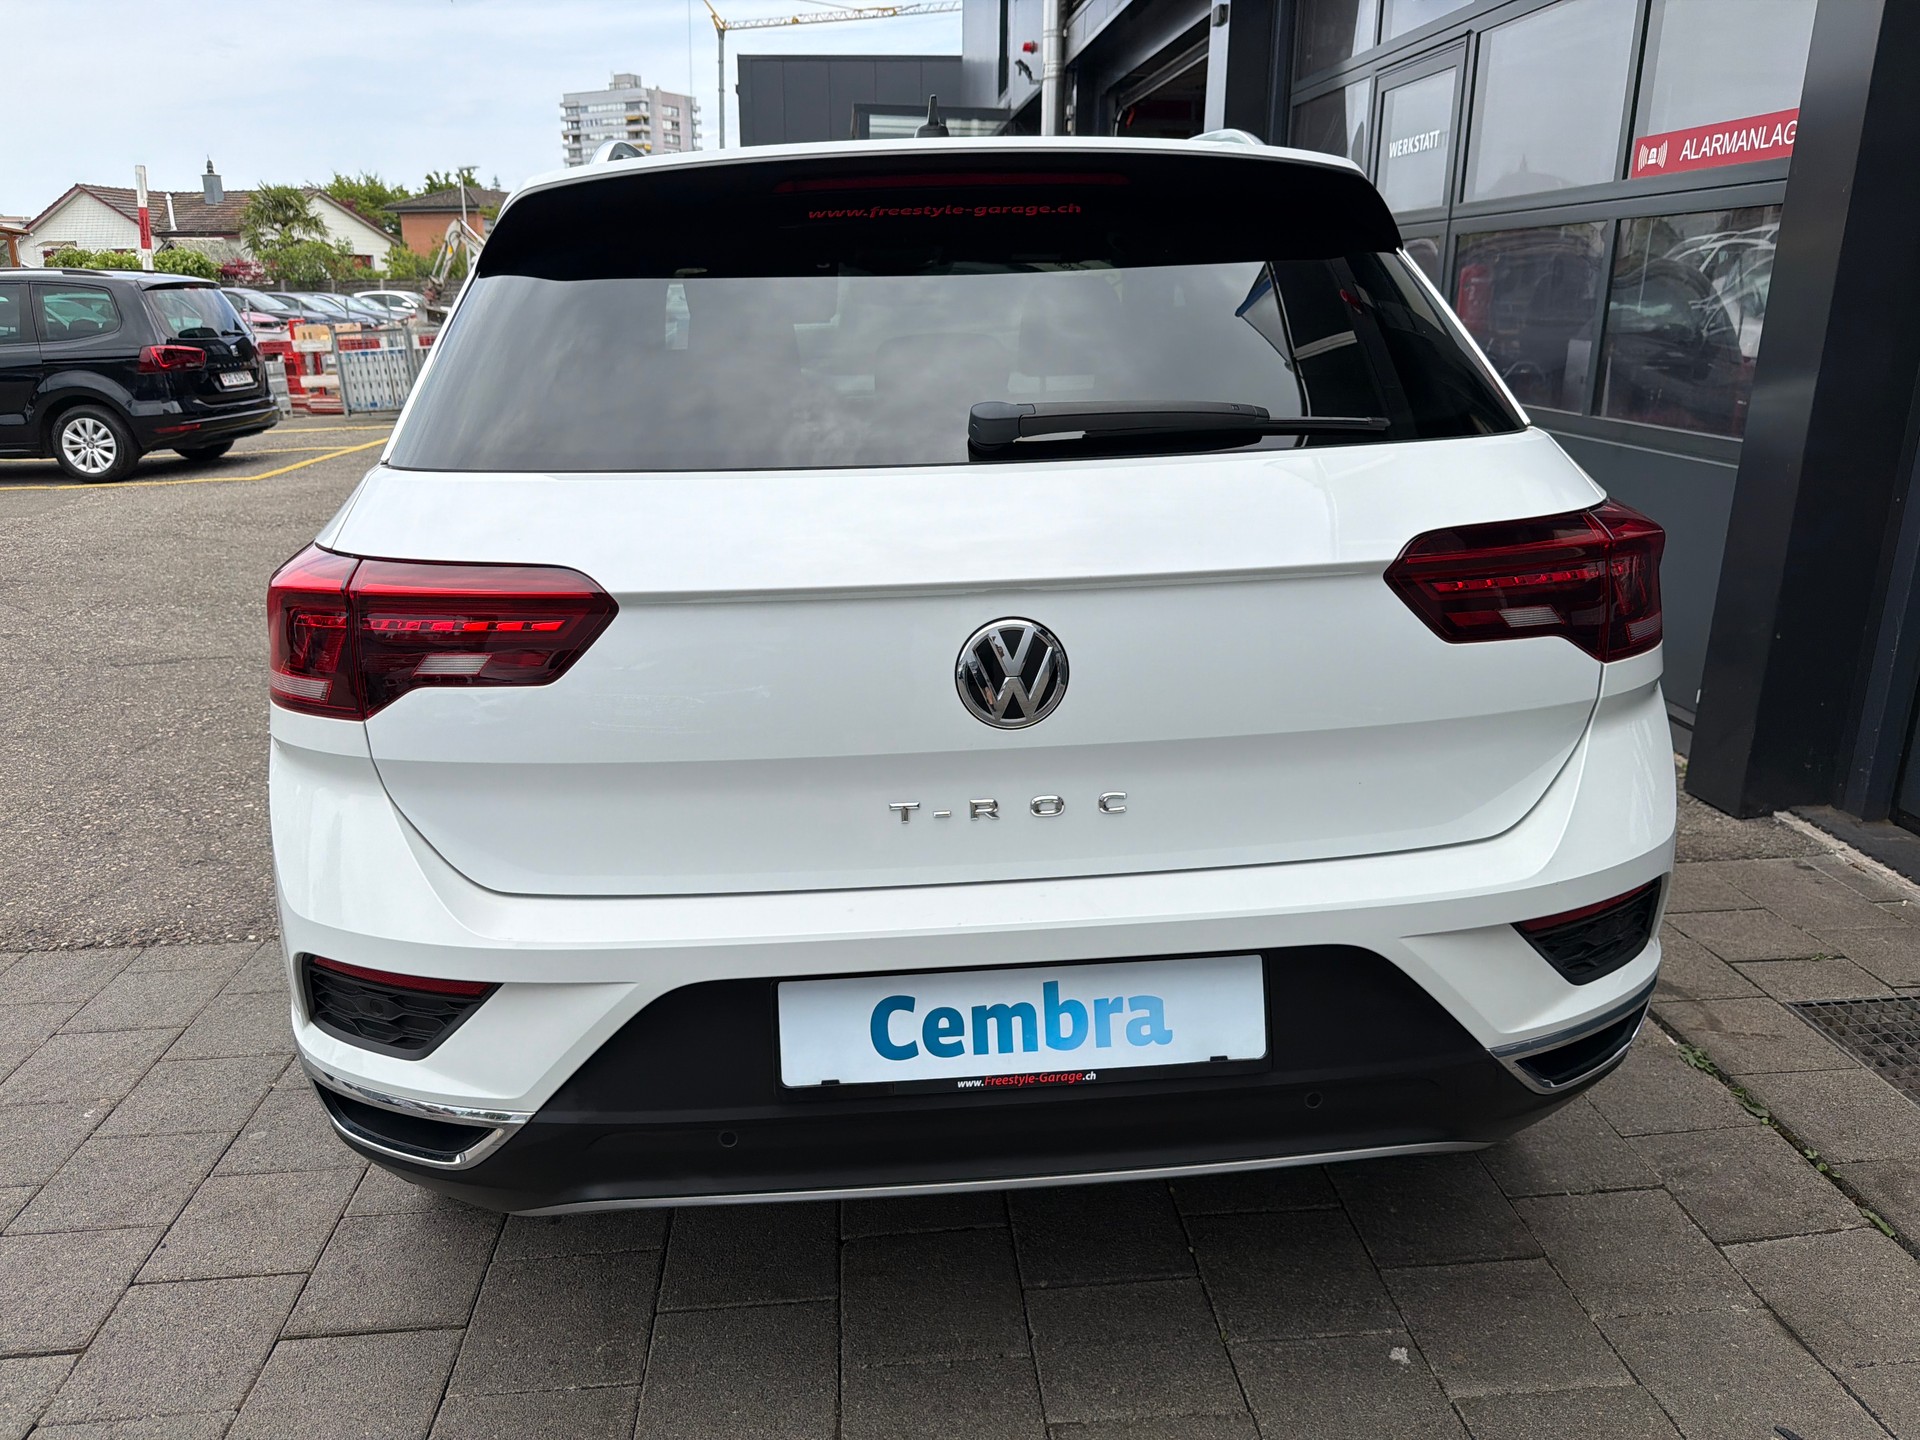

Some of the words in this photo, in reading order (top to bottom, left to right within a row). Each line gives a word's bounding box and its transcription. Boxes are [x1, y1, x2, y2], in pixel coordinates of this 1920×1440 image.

[1389, 130, 1440, 158] WERKSTATT
[808, 203, 1082, 218] www.freestyle-garage.ch
[957, 618, 1067, 727] VW
[889, 791, 1127, 824] T-ROC
[870, 980, 1173, 1061] Cembra
[957, 1070, 1097, 1088] www.Freestyle-Garage.ch
